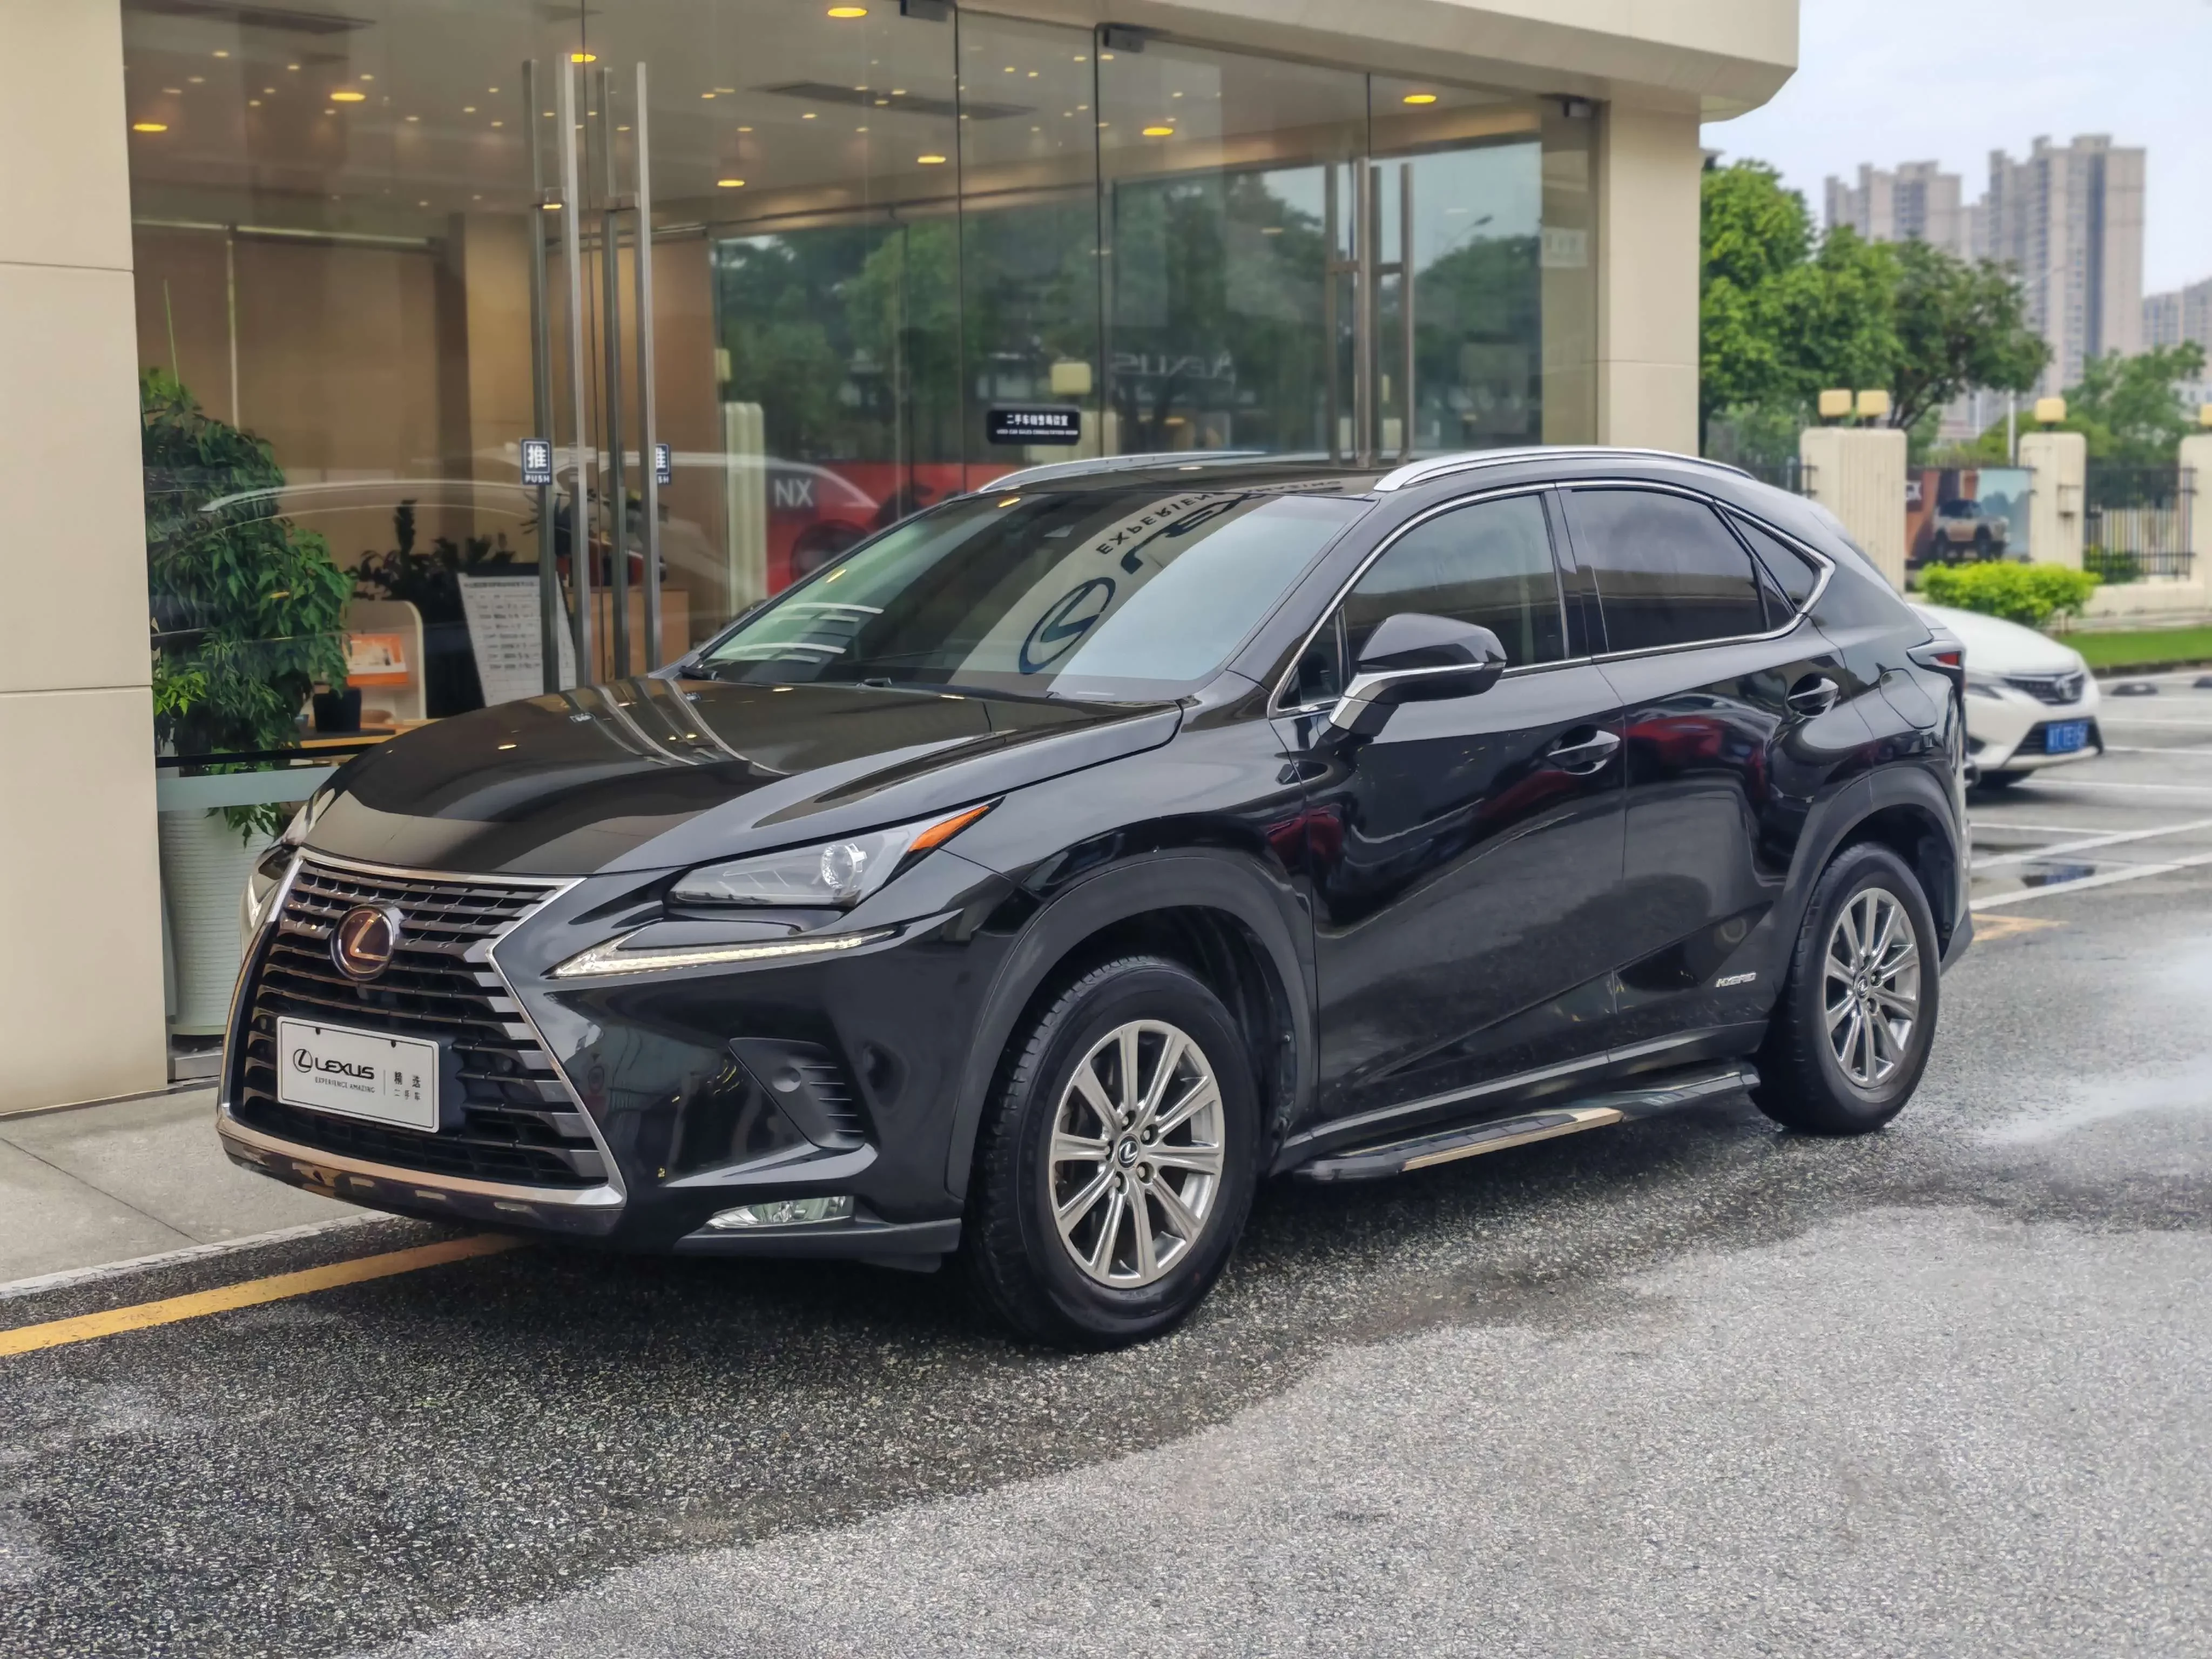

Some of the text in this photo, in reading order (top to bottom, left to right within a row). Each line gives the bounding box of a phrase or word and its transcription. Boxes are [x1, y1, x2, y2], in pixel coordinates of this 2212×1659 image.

[527, 444, 547, 468] 推
[524, 475, 550, 483] PUSH
[657, 475, 670, 484] SH
[774, 478, 814, 508] NX
[315, 1057, 375, 1080] LEXUS
[315, 1076, 348, 1089] EXPERIENCE
